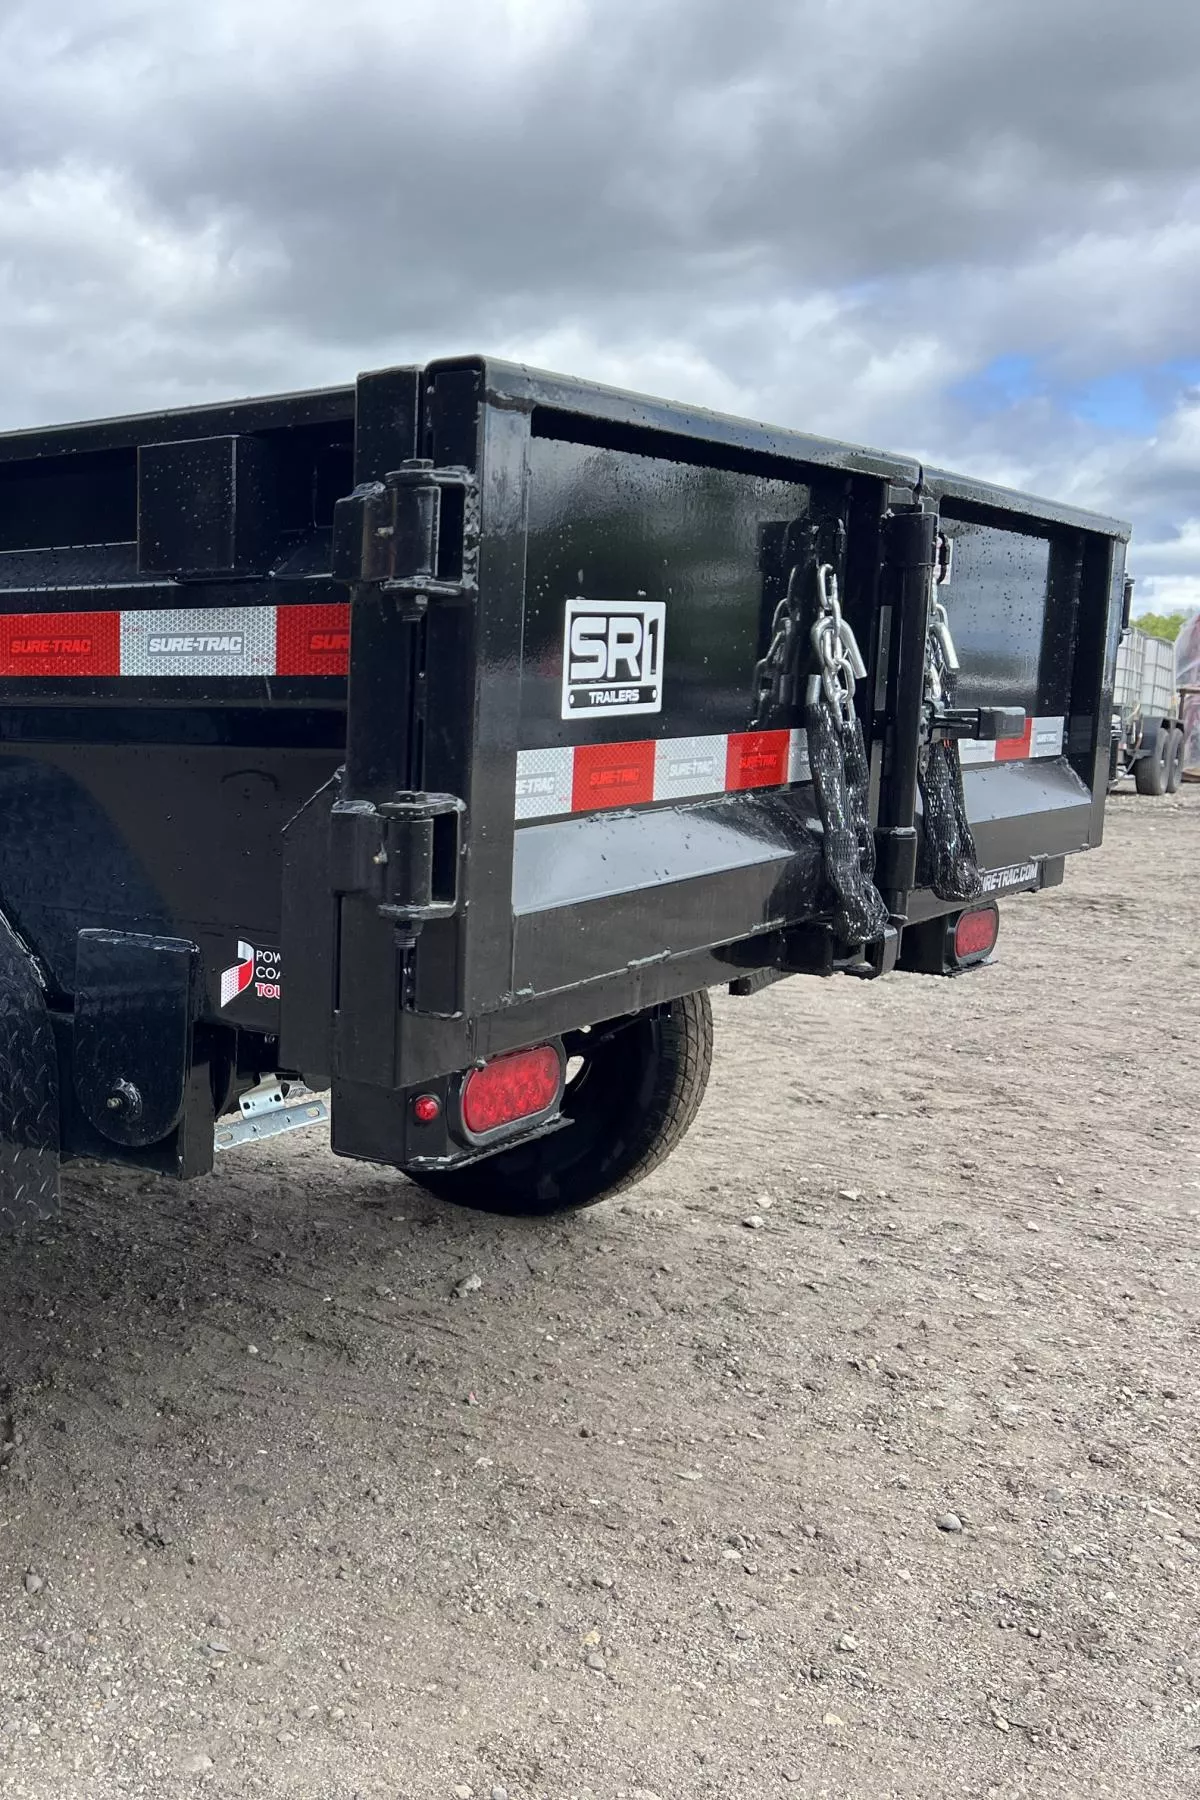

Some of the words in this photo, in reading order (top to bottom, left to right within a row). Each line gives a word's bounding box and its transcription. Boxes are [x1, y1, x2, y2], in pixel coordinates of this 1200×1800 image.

[11, 639, 92, 654] SURE-TRAC
[149, 636, 243, 653] SURE-TRAC
[588, 689, 640, 704] TRAILERS
